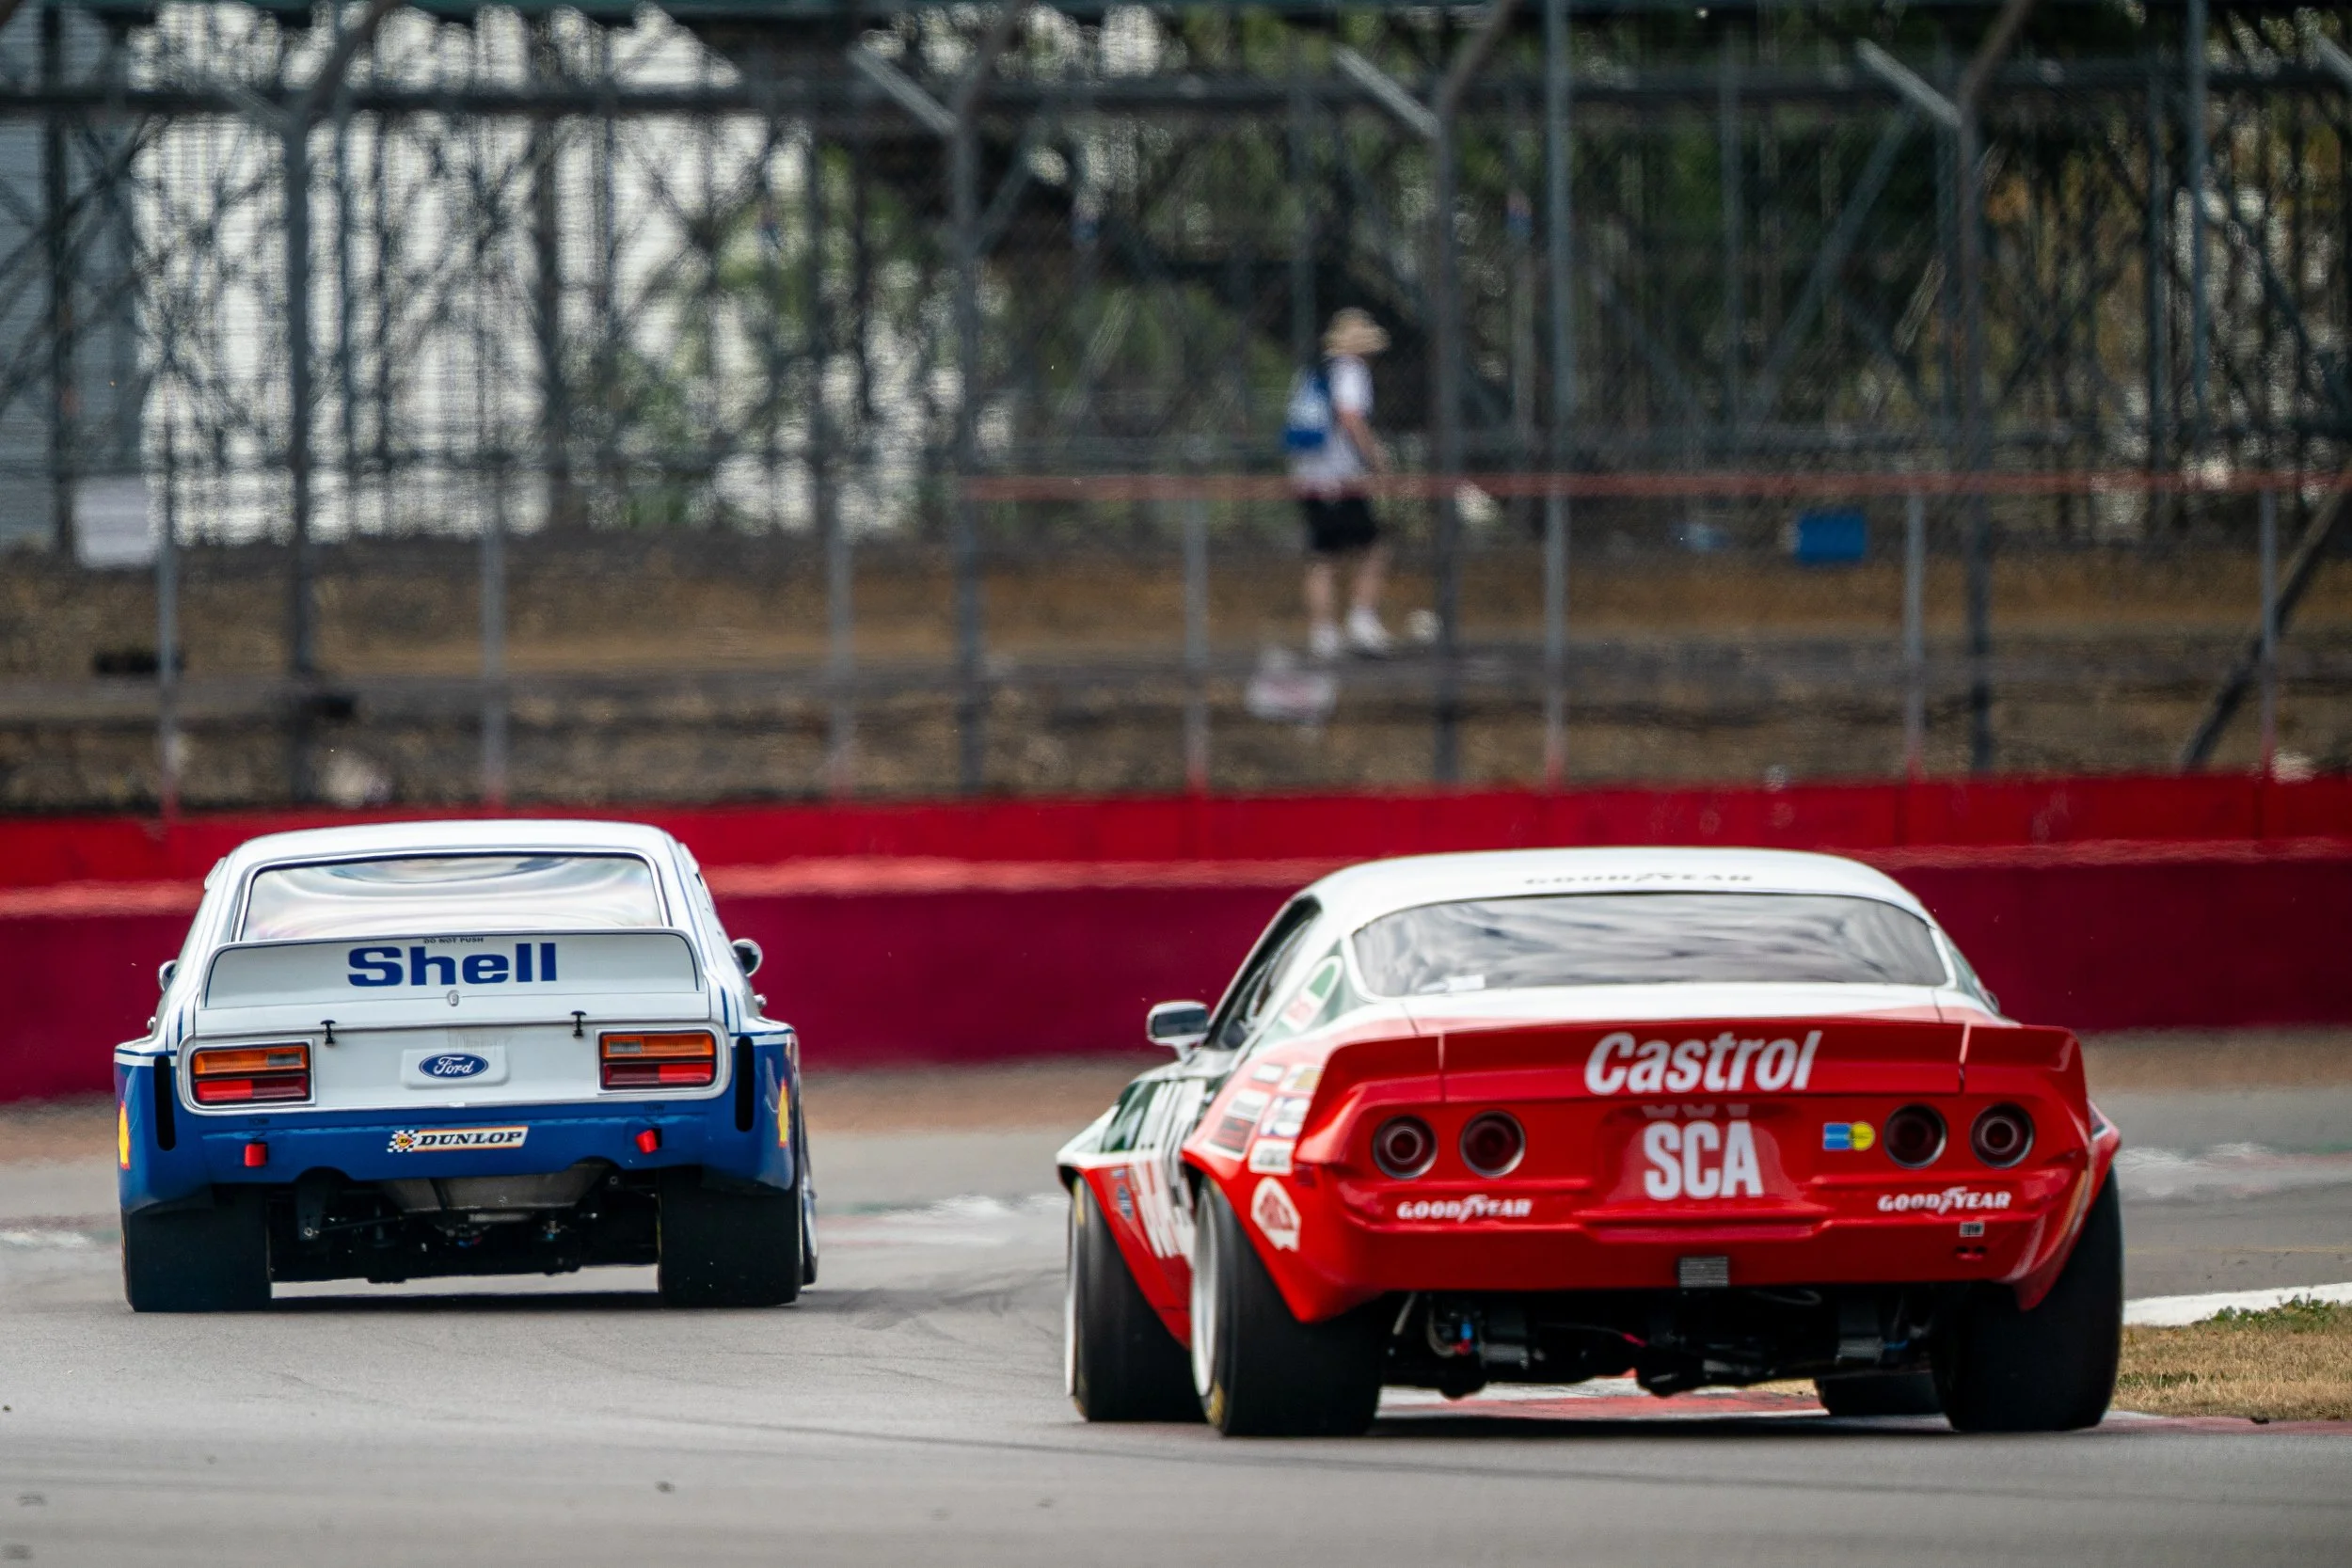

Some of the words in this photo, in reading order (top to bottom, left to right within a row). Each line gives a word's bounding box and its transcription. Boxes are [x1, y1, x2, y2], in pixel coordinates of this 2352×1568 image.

[348, 942, 557, 987] Shell
[434, 1056, 474, 1075] Ford
[1584, 1030, 1822, 1095] Castrol
[419, 1132, 522, 1146] DUNLOP
[1644, 1120, 1764, 1200] SCA
[1397, 1194, 1533, 1223] GOODYEAR
[1877, 1186, 2012, 1215] GOODYEAR
